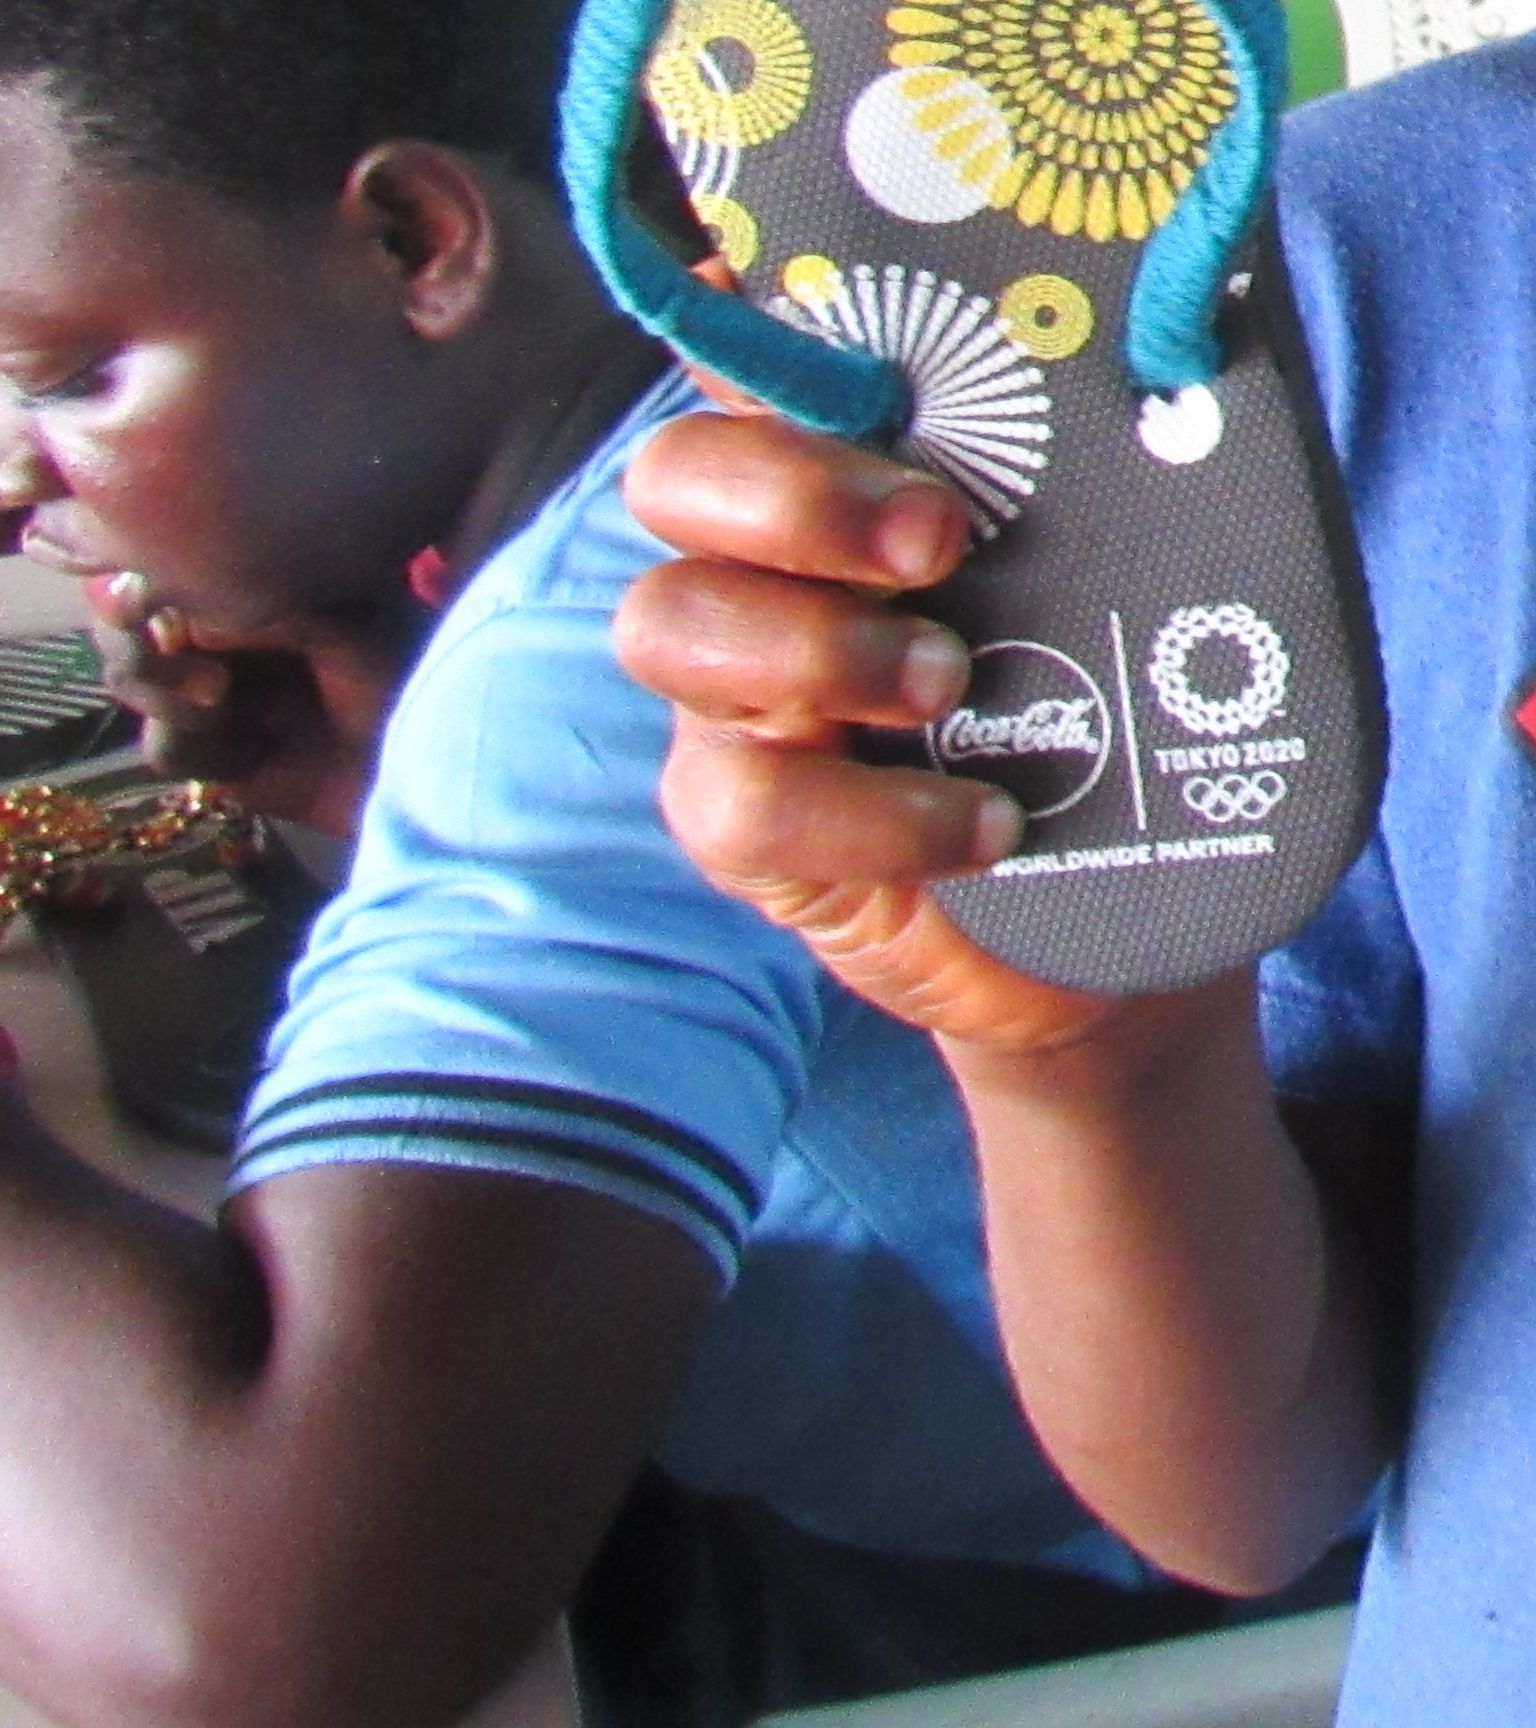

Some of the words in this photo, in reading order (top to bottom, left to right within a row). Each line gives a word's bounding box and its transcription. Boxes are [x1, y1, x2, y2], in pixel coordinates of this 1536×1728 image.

[1153, 742, 1240, 774] TOKYO
[1242, 736, 1306, 767] 2020
[1155, 832, 1275, 862] PARTNER
